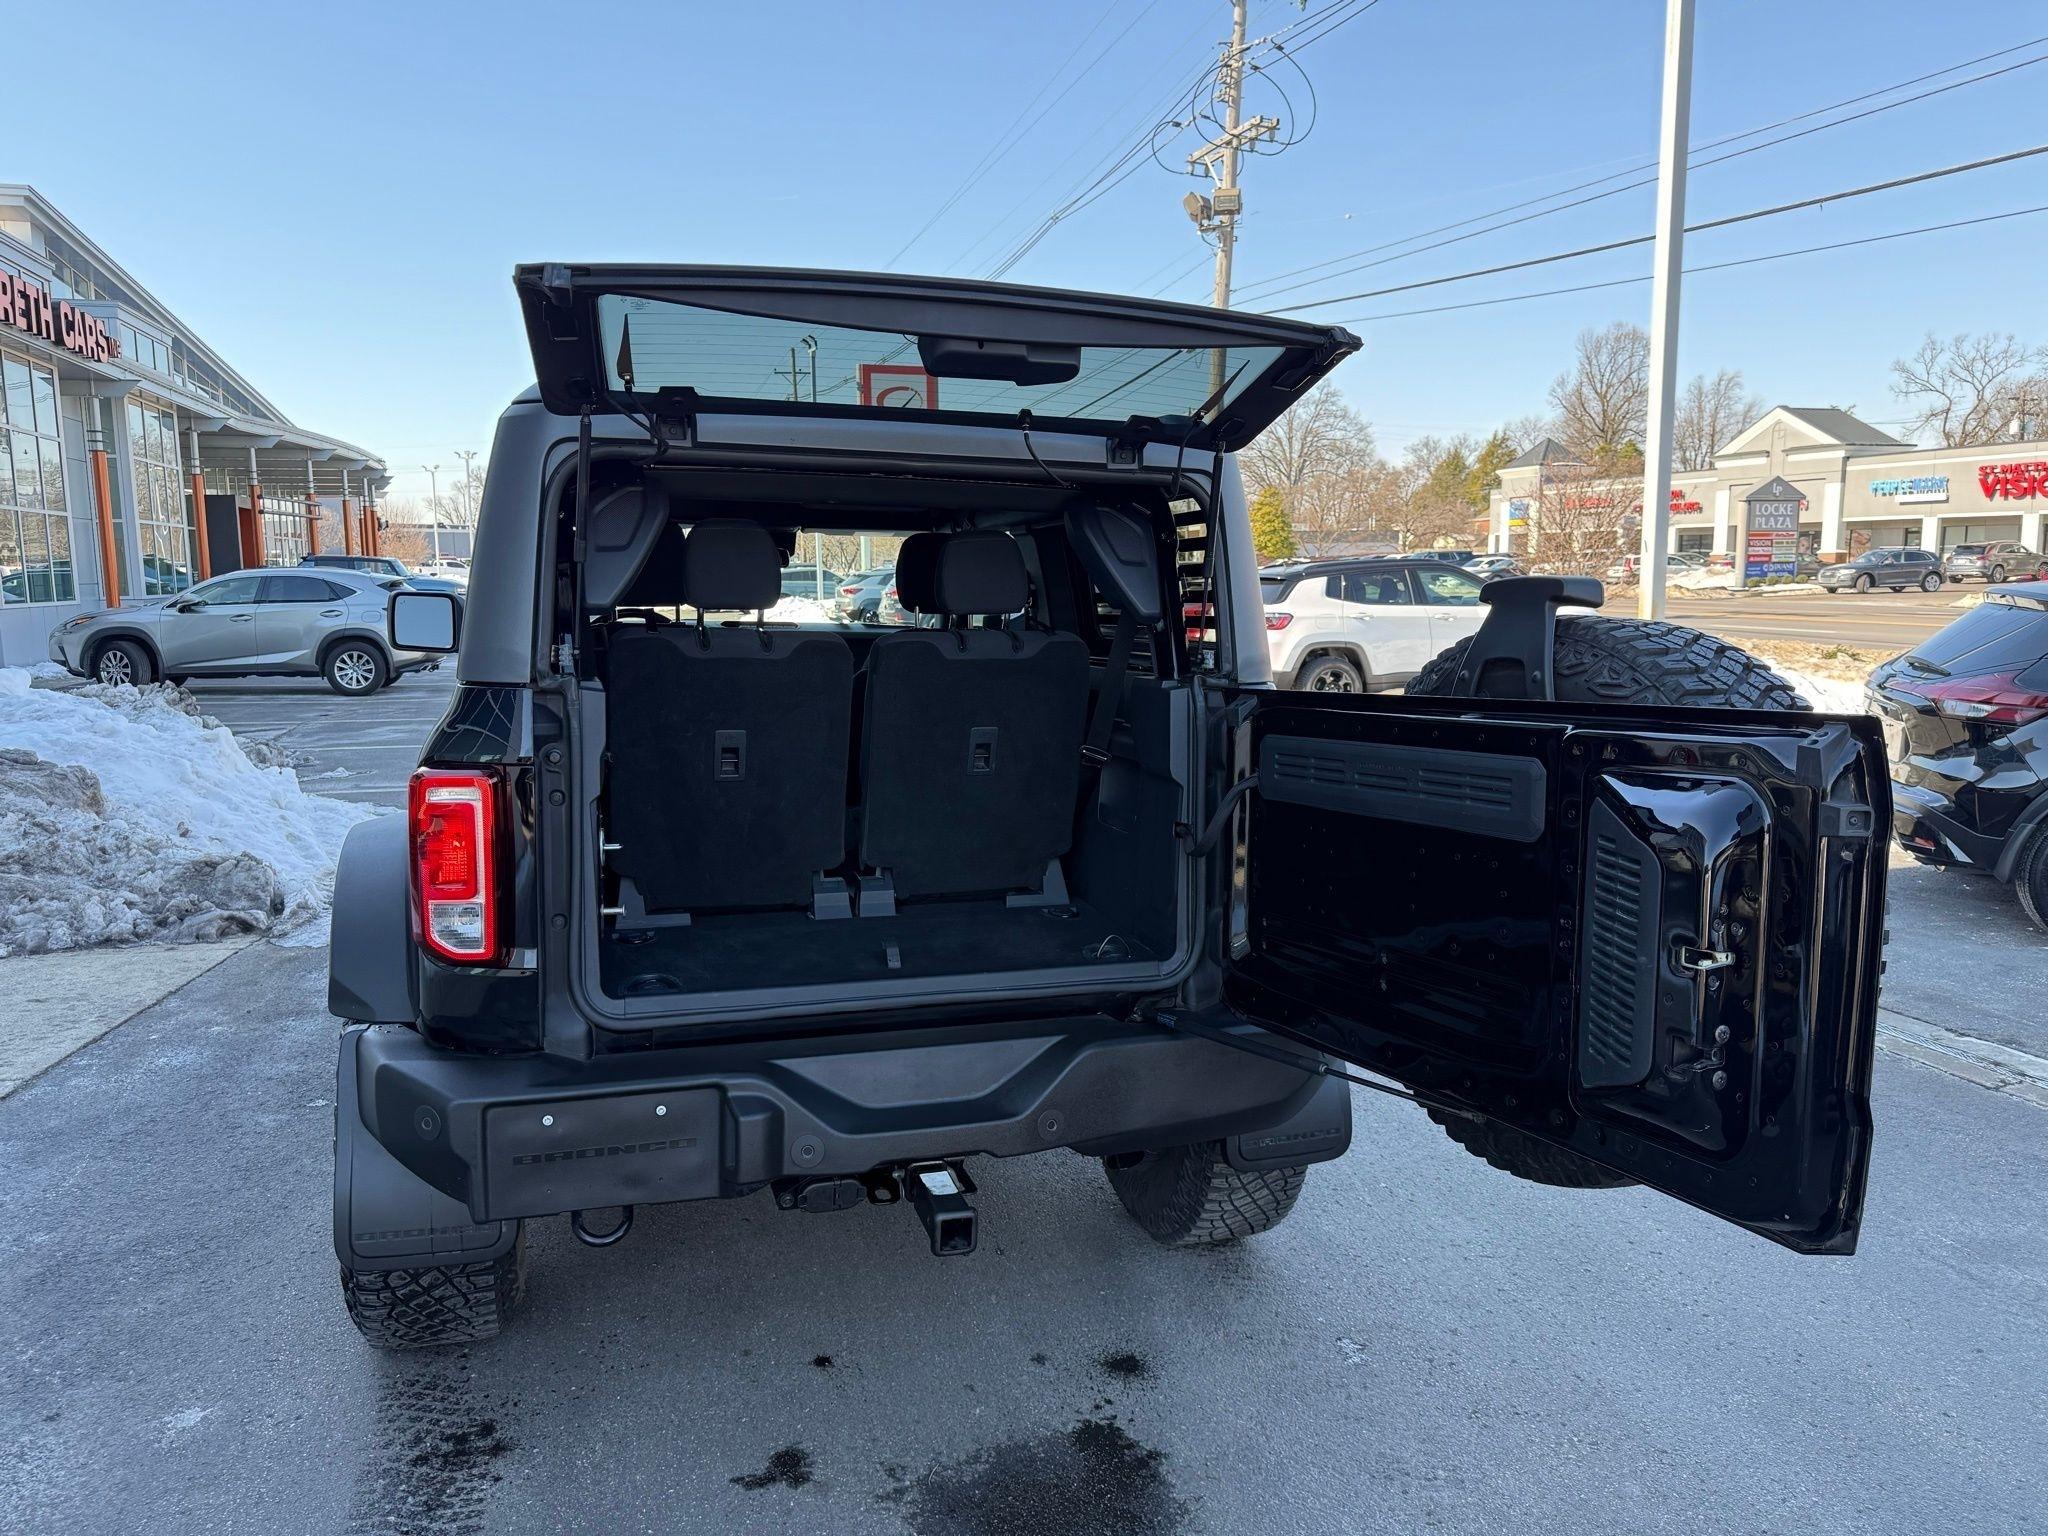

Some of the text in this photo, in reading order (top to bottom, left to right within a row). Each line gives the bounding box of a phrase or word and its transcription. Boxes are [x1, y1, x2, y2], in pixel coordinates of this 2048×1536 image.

[60, 300, 110, 363] CARS
[1755, 503, 1793, 515] LOCKE
[1755, 517, 1792, 528] PLAZA
[512, 1137, 698, 1166] BRONCO
